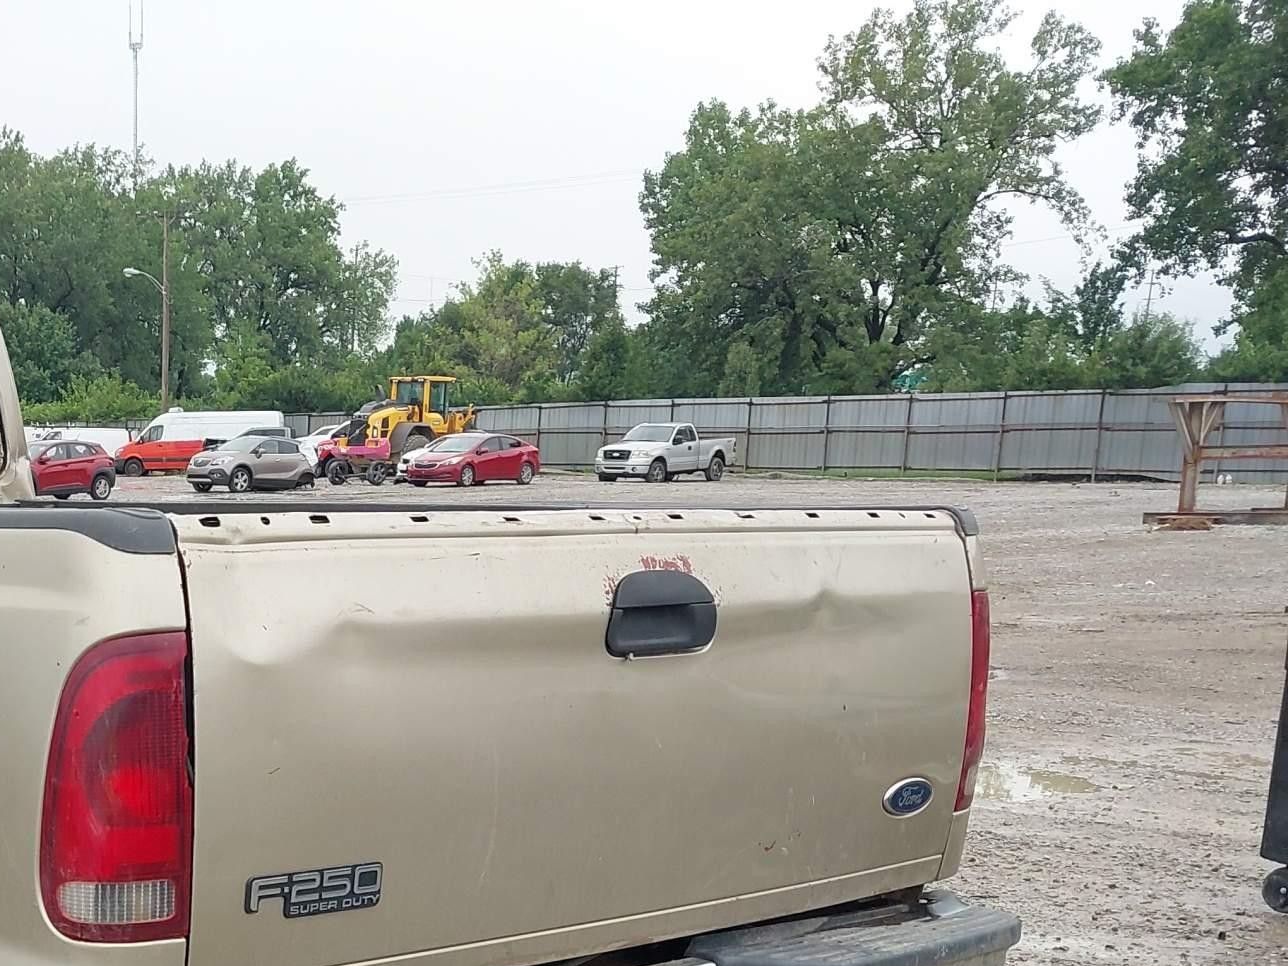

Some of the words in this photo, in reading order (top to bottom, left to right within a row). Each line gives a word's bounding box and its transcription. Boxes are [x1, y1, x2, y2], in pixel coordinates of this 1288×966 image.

[898, 786, 925, 807] Ford
[289, 900, 339, 915] SUPER
[341, 893, 381, 908] DUTY
